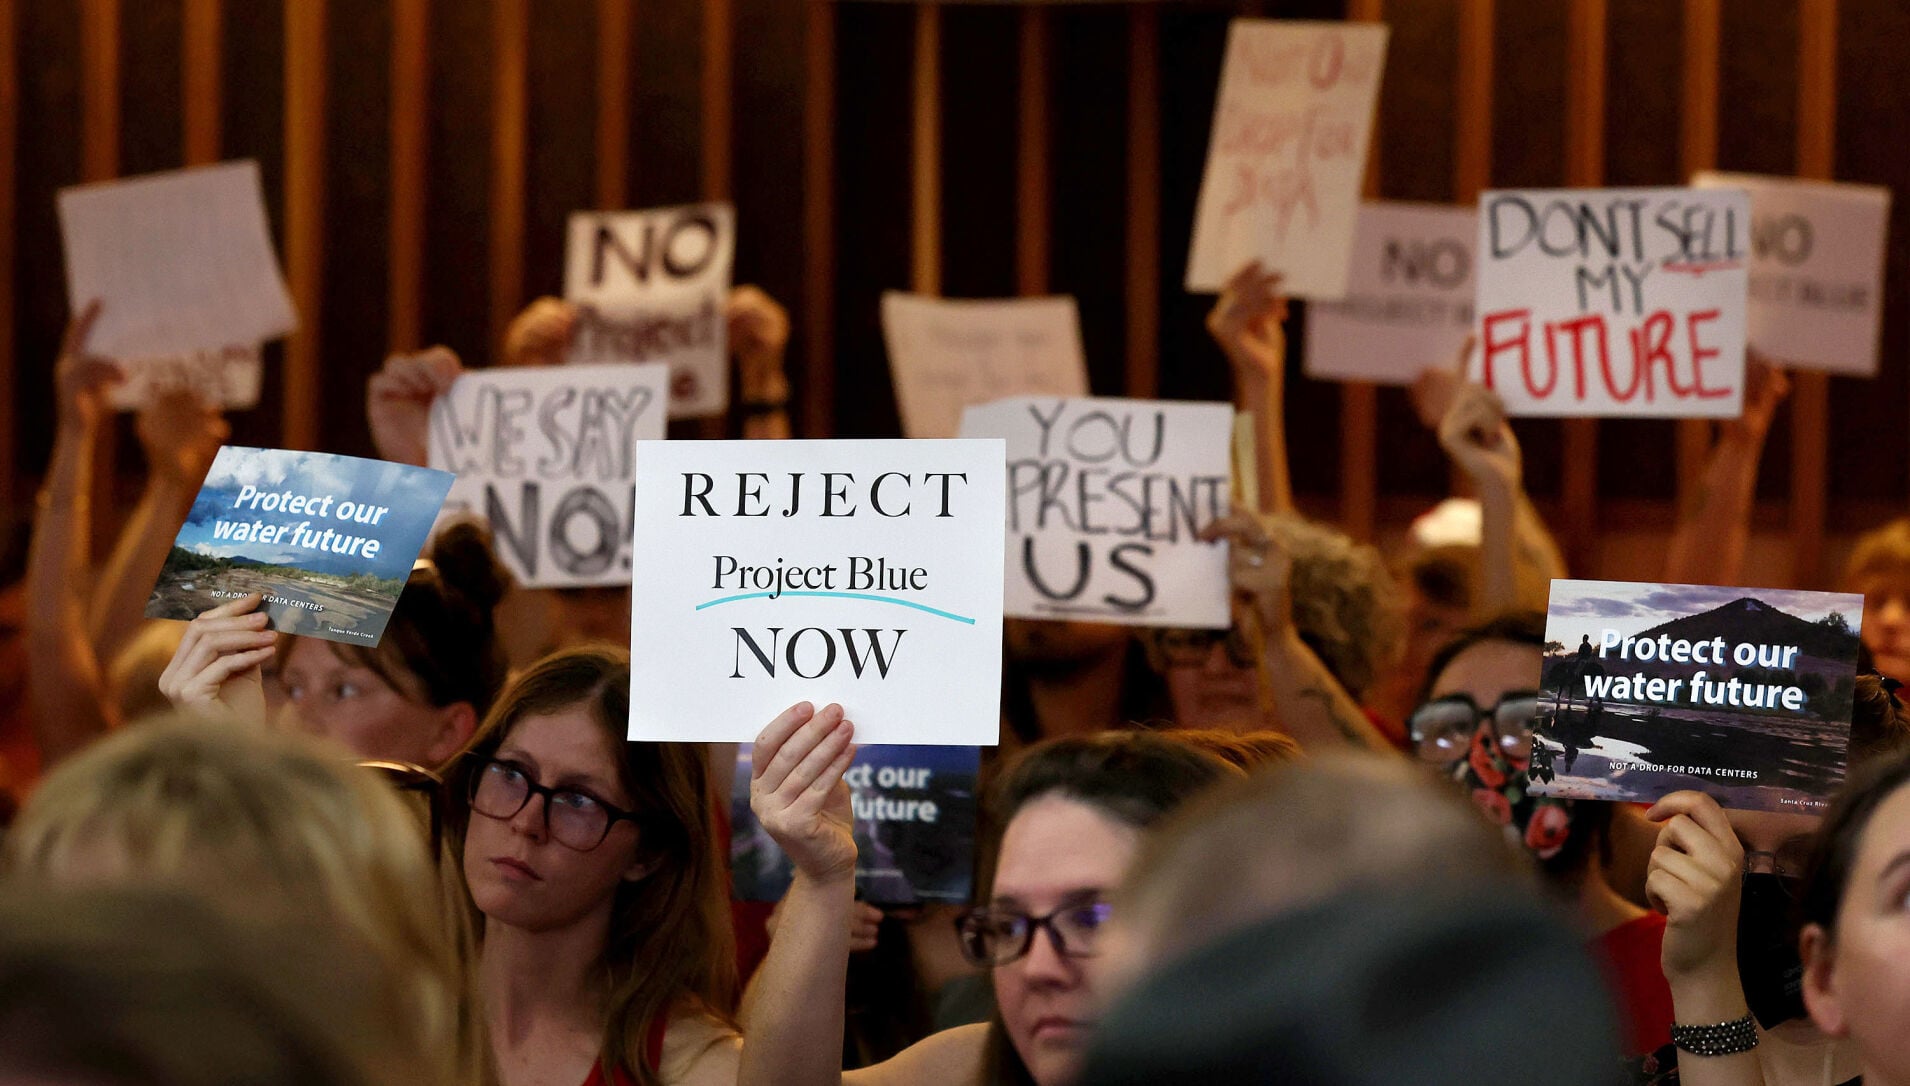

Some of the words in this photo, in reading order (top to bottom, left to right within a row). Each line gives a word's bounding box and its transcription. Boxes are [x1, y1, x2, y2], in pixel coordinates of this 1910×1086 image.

[590, 213, 718, 286] NO
[1490, 197, 1645, 262] DONT
[1654, 201, 1745, 262] SELL
[1381, 237, 1471, 291] NO
[1575, 261, 1653, 315] MY
[1483, 308, 1734, 404] FUTURE
[431, 383, 535, 479] WE
[537, 384, 653, 481] SAY
[1028, 400, 1166, 468] YOU
[233, 485, 334, 518] Protect
[336, 499, 390, 526] our
[679, 471, 968, 518] REJECT
[1005, 458, 1228, 545] PRESENT
[213, 518, 288, 546] water
[289, 520, 380, 560] future
[711, 554, 837, 600] Project
[845, 556, 929, 591] Blue
[1022, 533, 1156, 610] US
[210, 590, 225, 598] NOT
[268, 596, 289, 606] DATA
[290, 599, 325, 612] CENTERS
[728, 627, 908, 681] NOW
[1598, 628, 1726, 665] Protect
[1733, 641, 1798, 670] our
[1584, 673, 1683, 703] water
[1690, 670, 1805, 711] future
[877, 765, 932, 789] our
[1609, 762, 1628, 771] NOT
[1630, 762, 1638, 771] A
[1639, 763, 1665, 772] DROP
[1667, 765, 1686, 774] FOR
[1687, 766, 1713, 776] DATA
[1715, 768, 1759, 780] CENTERS
